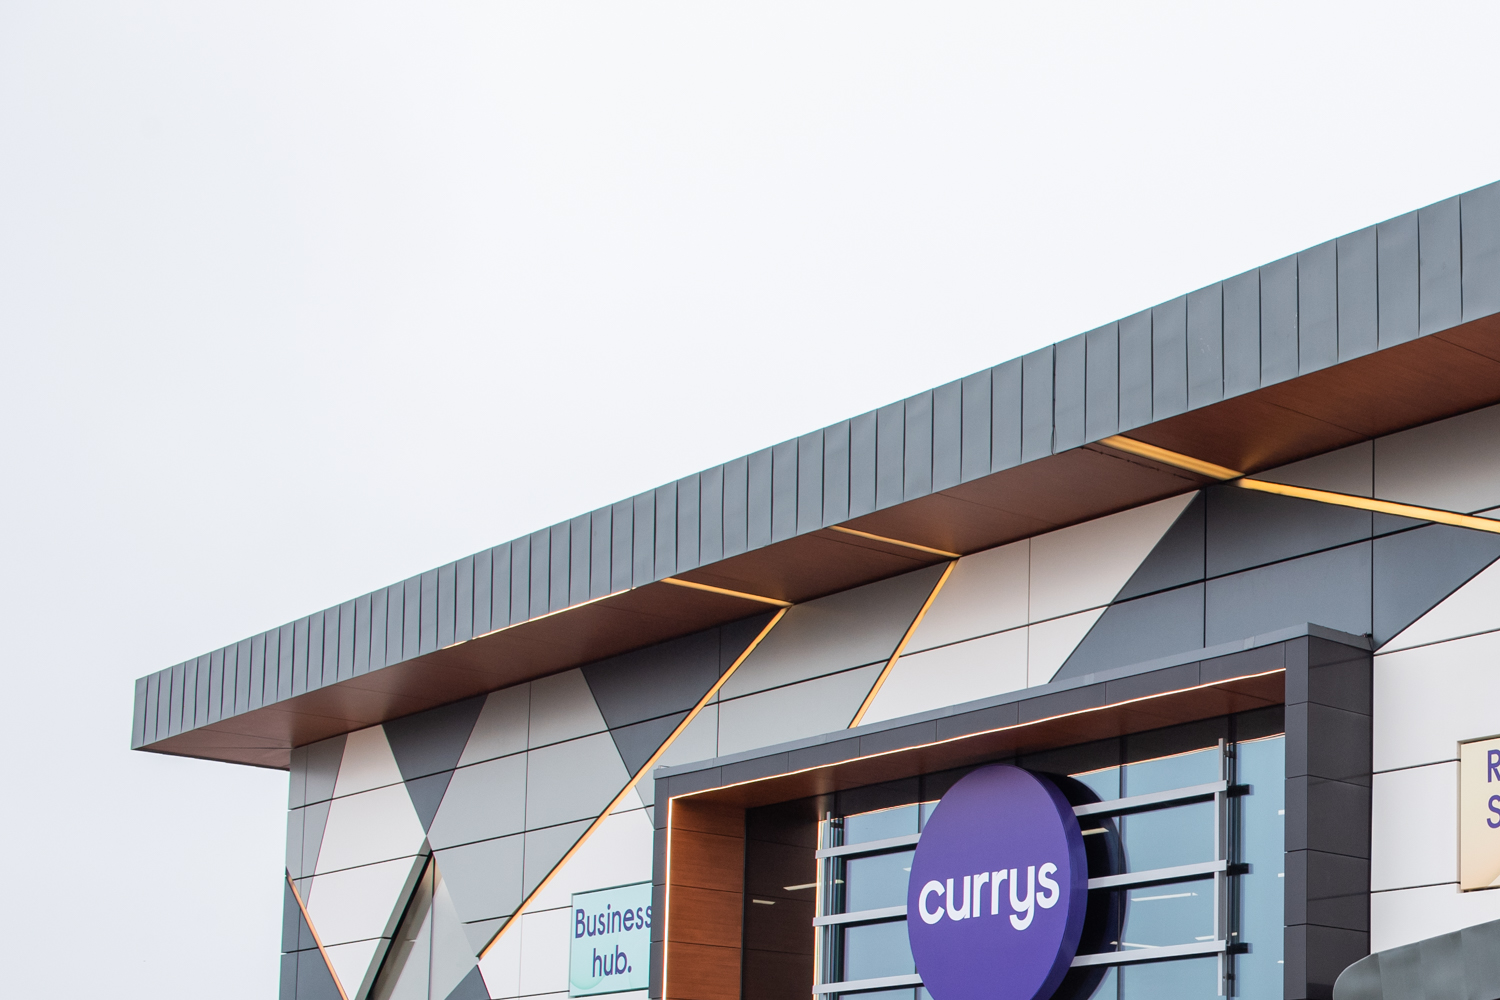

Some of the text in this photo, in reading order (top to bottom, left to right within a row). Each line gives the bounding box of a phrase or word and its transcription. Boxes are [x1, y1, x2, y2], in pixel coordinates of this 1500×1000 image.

[918, 862, 1060, 931] currys
[575, 904, 651, 939] Business
[592, 945, 632, 977] hub.
